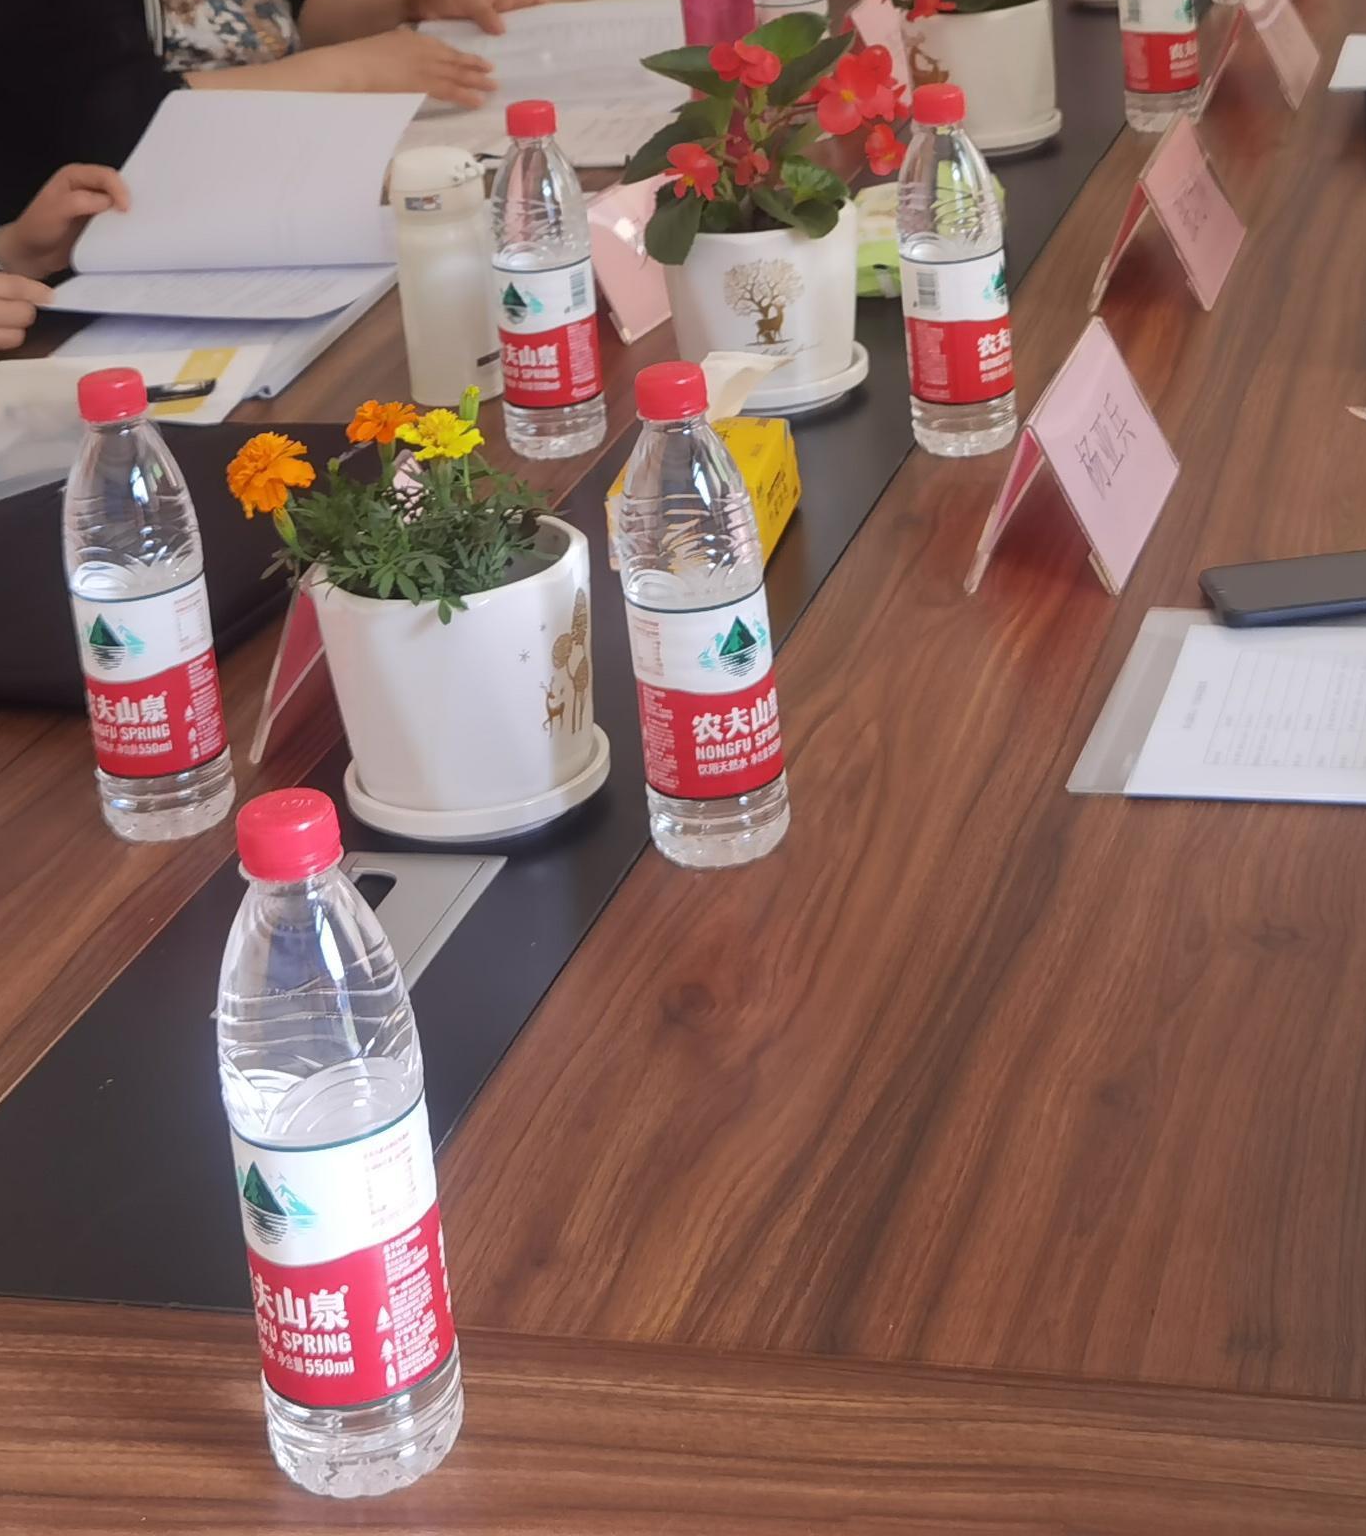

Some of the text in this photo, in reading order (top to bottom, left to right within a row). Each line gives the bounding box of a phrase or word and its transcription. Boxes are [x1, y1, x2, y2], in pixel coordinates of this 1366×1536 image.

[119, 723, 171, 741] SPRING
[696, 736, 752, 761] NONGFU
[281, 1329, 352, 1356] SPRING
